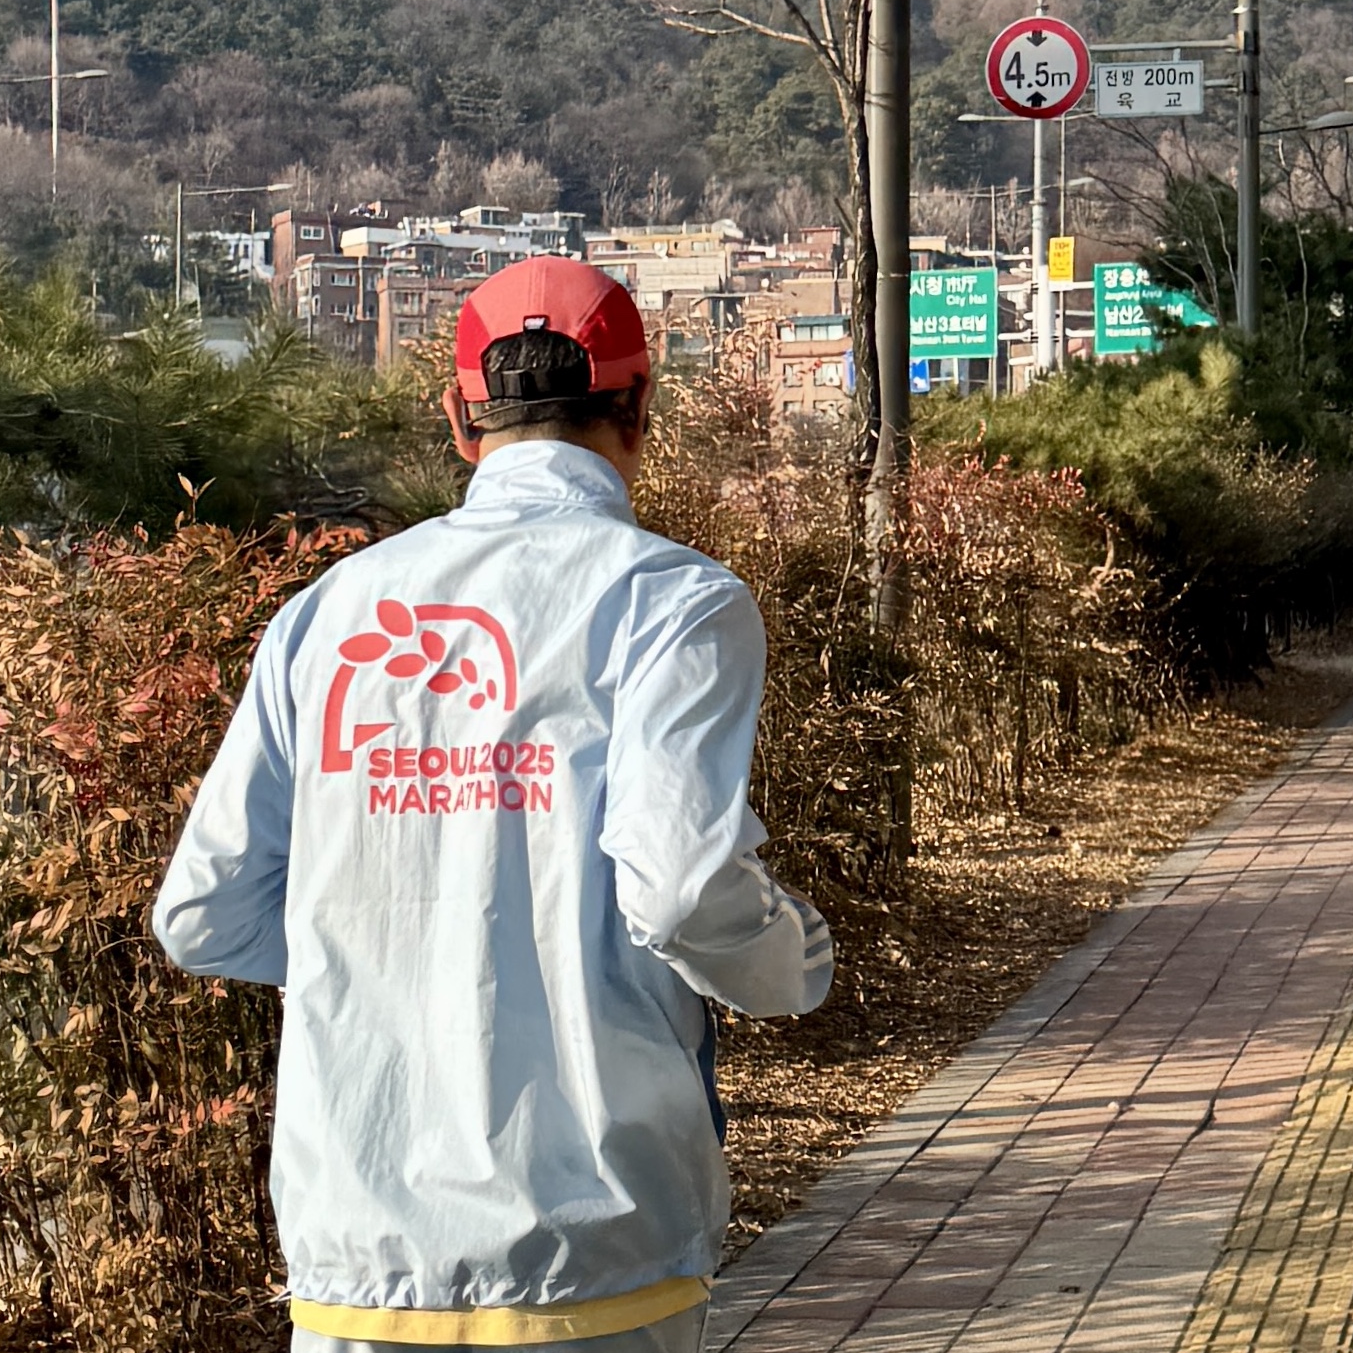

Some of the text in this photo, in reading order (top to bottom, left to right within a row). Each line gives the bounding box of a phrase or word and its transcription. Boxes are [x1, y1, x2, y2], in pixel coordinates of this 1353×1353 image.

[1004, 51, 1071, 90] 4.5m
[1105, 67, 1195, 87] 전방 200m
[909, 275, 944, 297] 시청
[368, 742, 555, 779] SEOUL 2025
[368, 780, 553, 815] MARATHON
